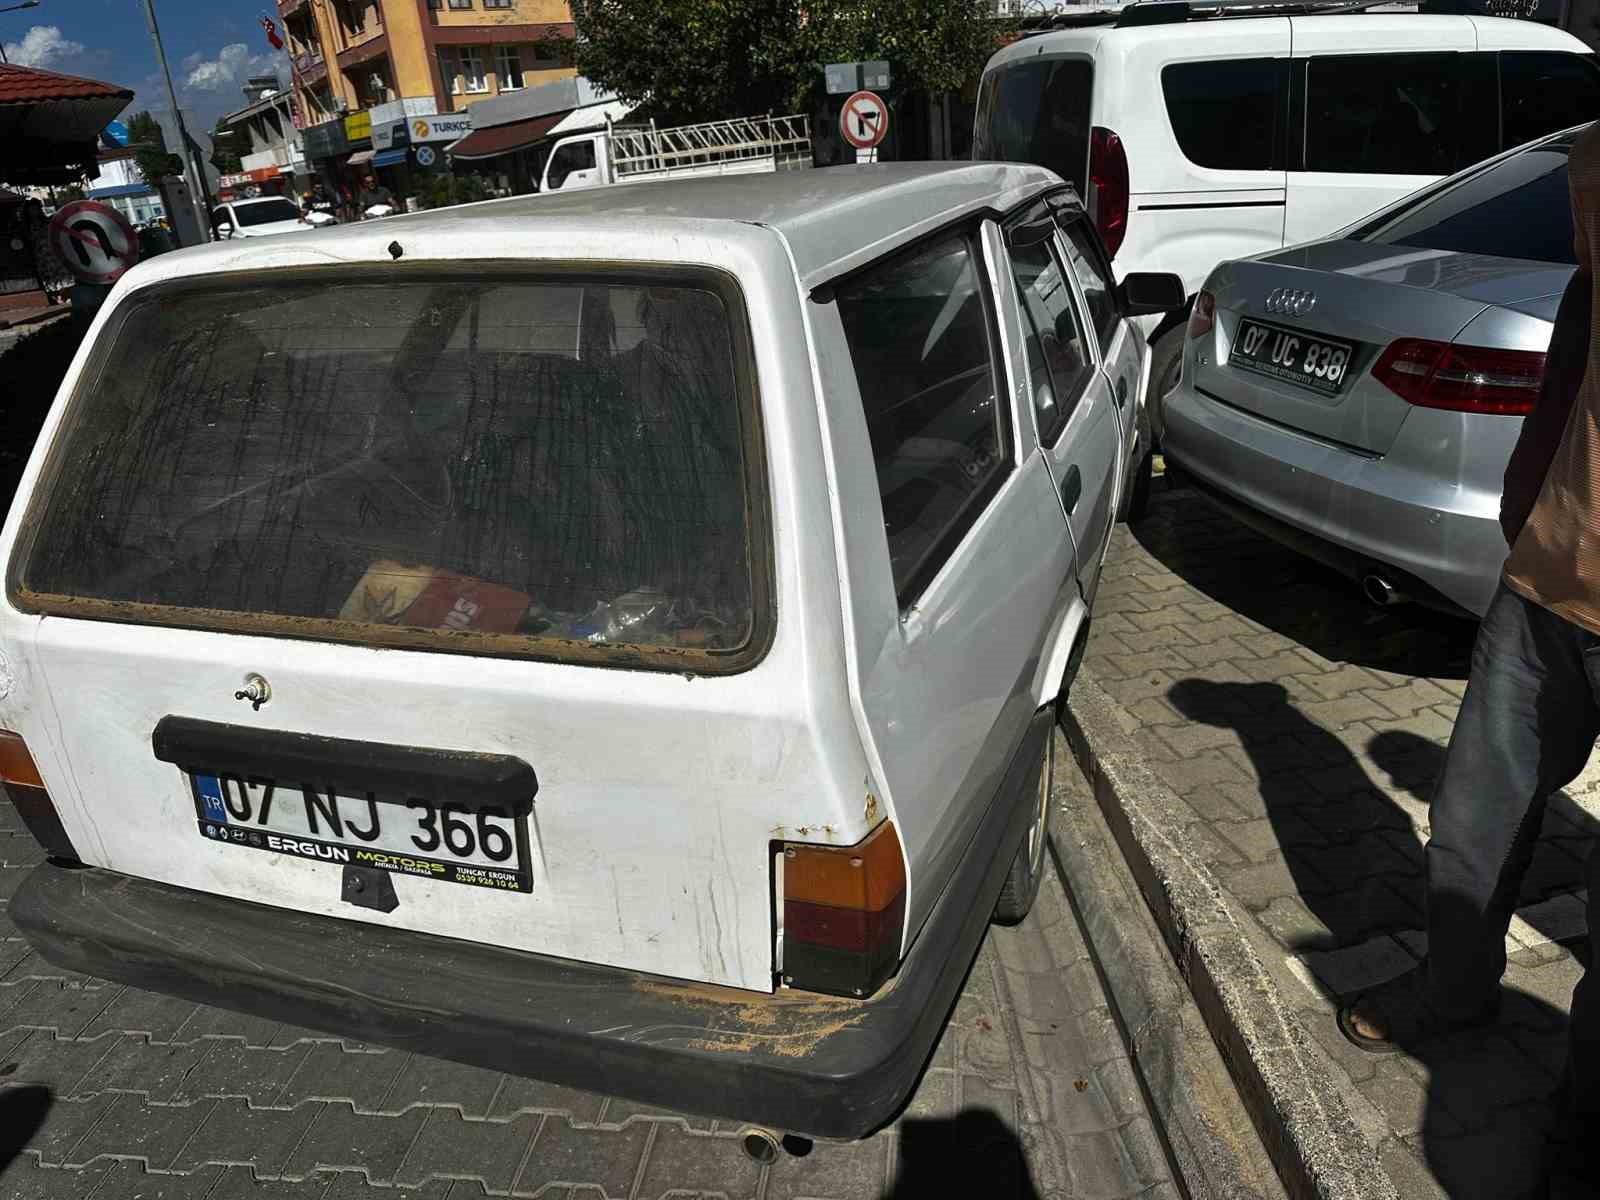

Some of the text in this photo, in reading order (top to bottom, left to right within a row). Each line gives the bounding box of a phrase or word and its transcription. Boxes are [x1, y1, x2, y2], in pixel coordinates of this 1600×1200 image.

[1243, 326, 1270, 357] 07
[1271, 334, 1301, 367] UC
[1303, 343, 1345, 381] 838
[201, 794, 223, 811] TR
[220, 775, 513, 862] 07 NJ 366
[267, 836, 446, 873] ERGUN MOTORS
[488, 871, 516, 881] ERGUN
